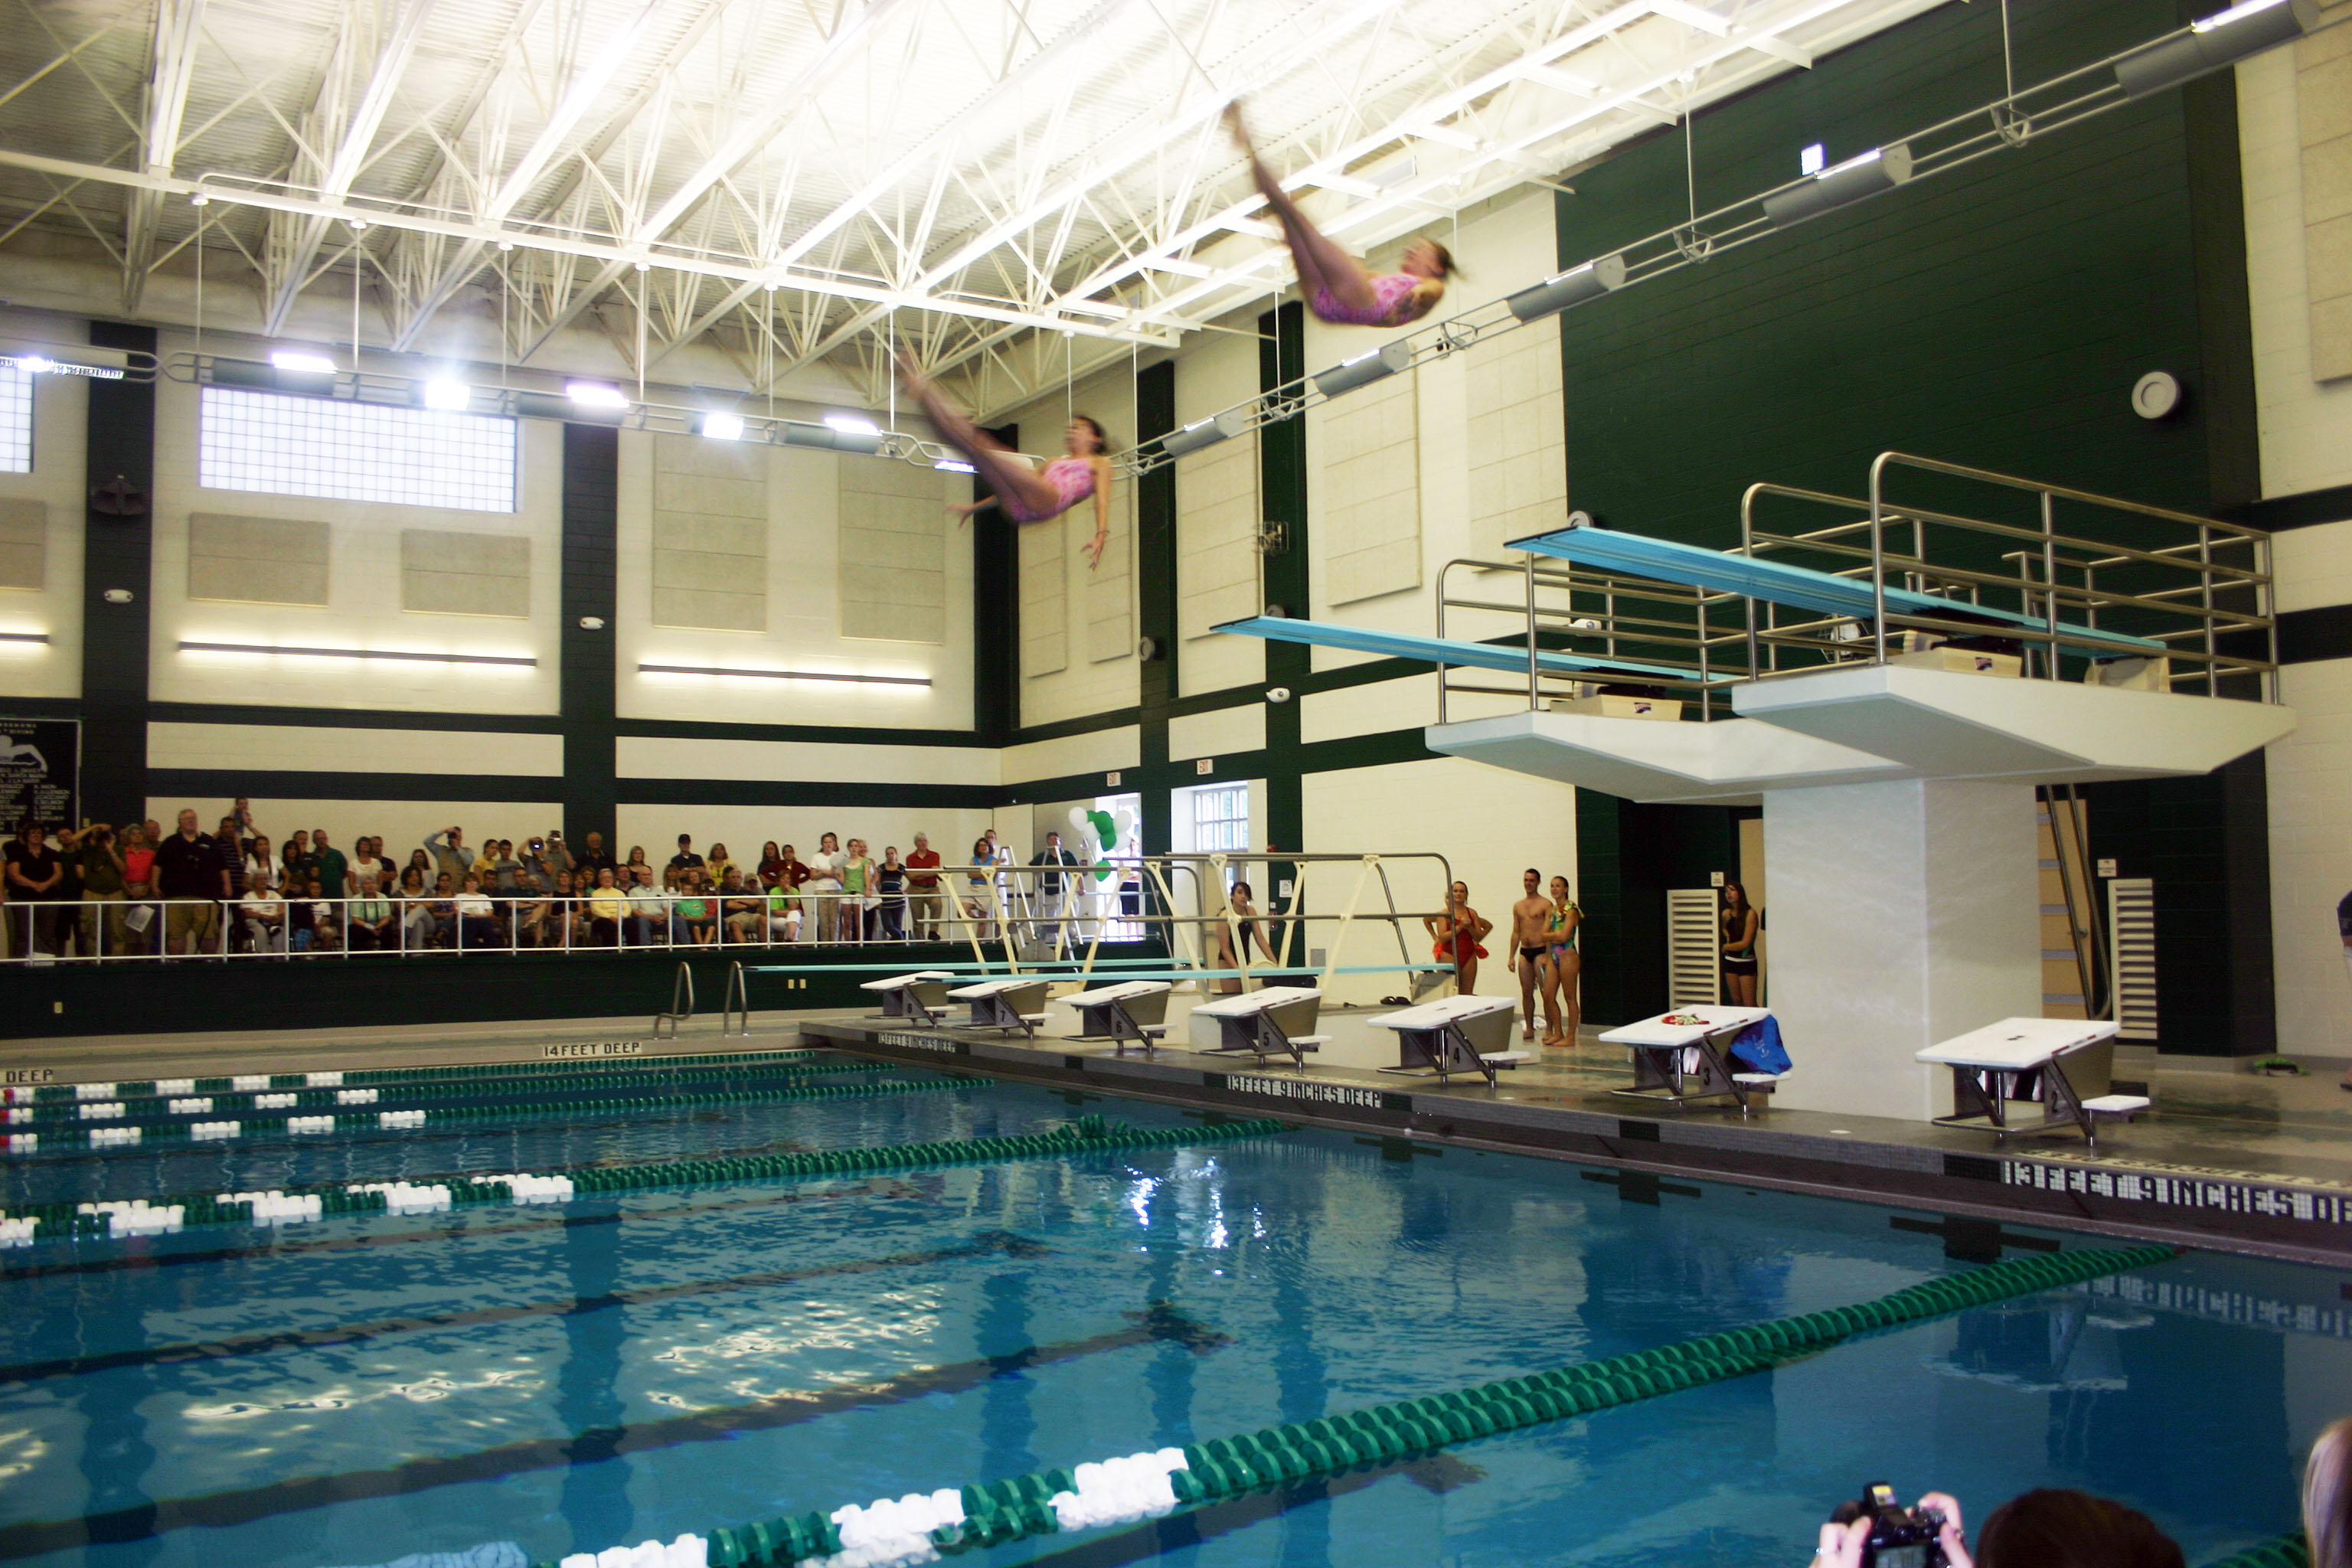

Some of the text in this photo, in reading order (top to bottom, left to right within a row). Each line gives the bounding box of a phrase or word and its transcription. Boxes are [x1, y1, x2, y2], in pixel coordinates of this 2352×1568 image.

[1001, 1011, 1005, 1022] 7
[1116, 1021, 1122, 1034] 6
[1263, 1032, 1269, 1046] 5
[544, 1042, 640, 1057] 14 FEET DEEP
[1453, 1047, 1461, 1063] 4
[6, 1069, 54, 1083] DEEP
[1704, 1067, 1710, 1086] 3
[1230, 1076, 1240, 1091] 13
[1243, 1076, 1274, 1096] FEET
[1290, 1081, 1338, 1104] INCHES
[1344, 1087, 1381, 1109] DEEP
[2051, 1090, 2058, 1114] 2
[2010, 1161, 2035, 1187] 13
[2044, 1165, 2123, 1197] FEET
[2139, 1176, 2157, 1201] 9
[2165, 1178, 2295, 1219] INCHES
